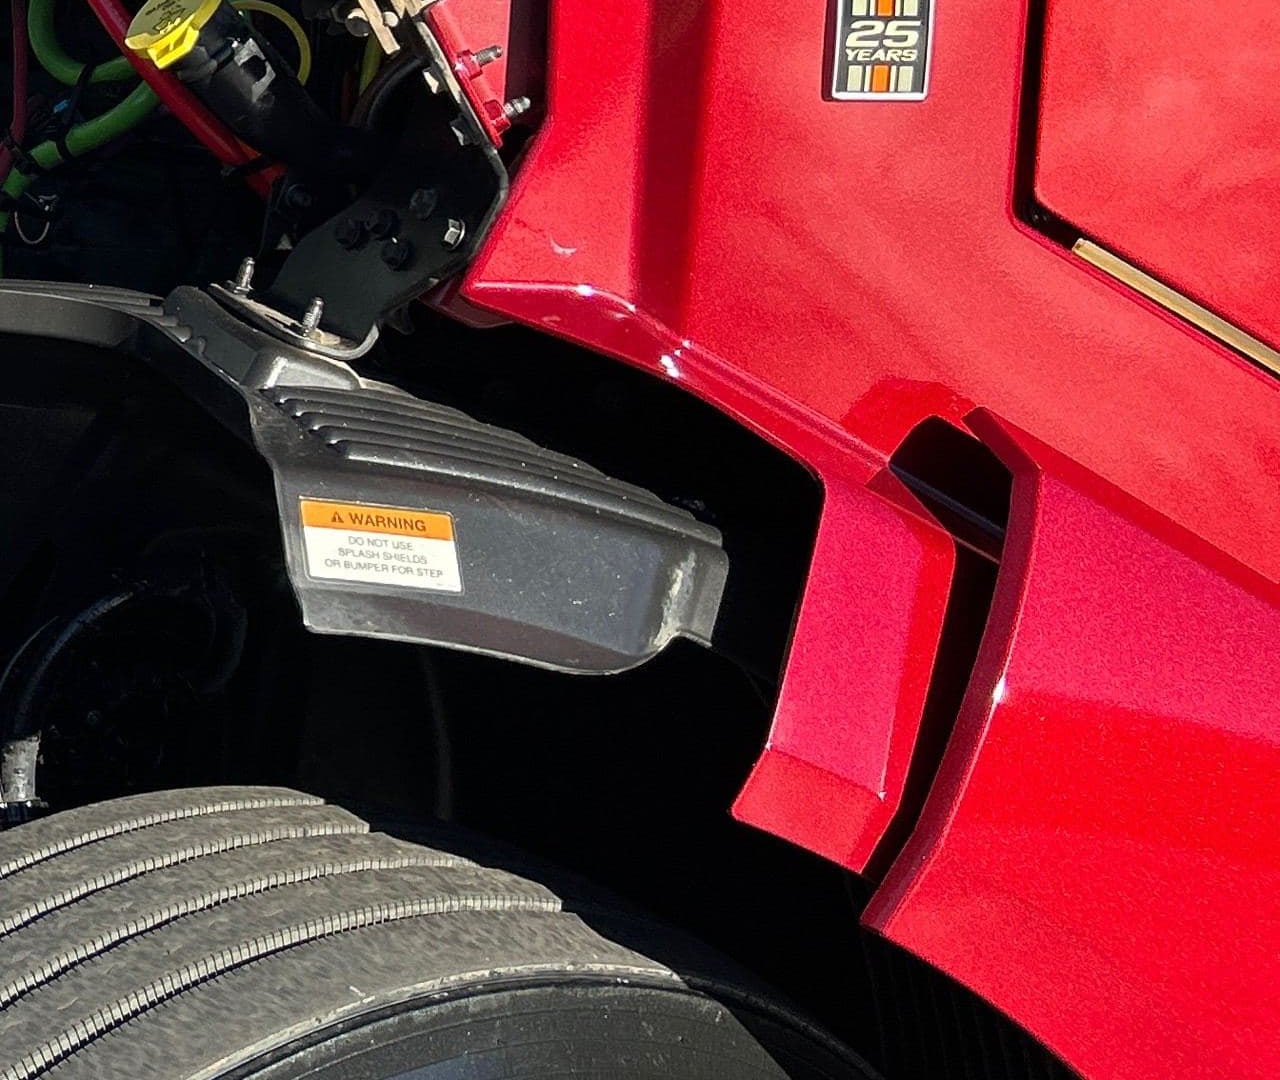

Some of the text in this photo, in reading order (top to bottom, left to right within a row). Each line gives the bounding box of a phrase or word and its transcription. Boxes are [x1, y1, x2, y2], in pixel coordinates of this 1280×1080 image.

[845, 20, 922, 48] 25
[845, 49, 918, 62] YEARS
[348, 512, 427, 532] WARNING
[348, 536, 413, 551] DO NOT USE
[338, 547, 427, 564] SPLASH SHIELDS
[324, 558, 443, 578] OR BUMPER FOR STEP
